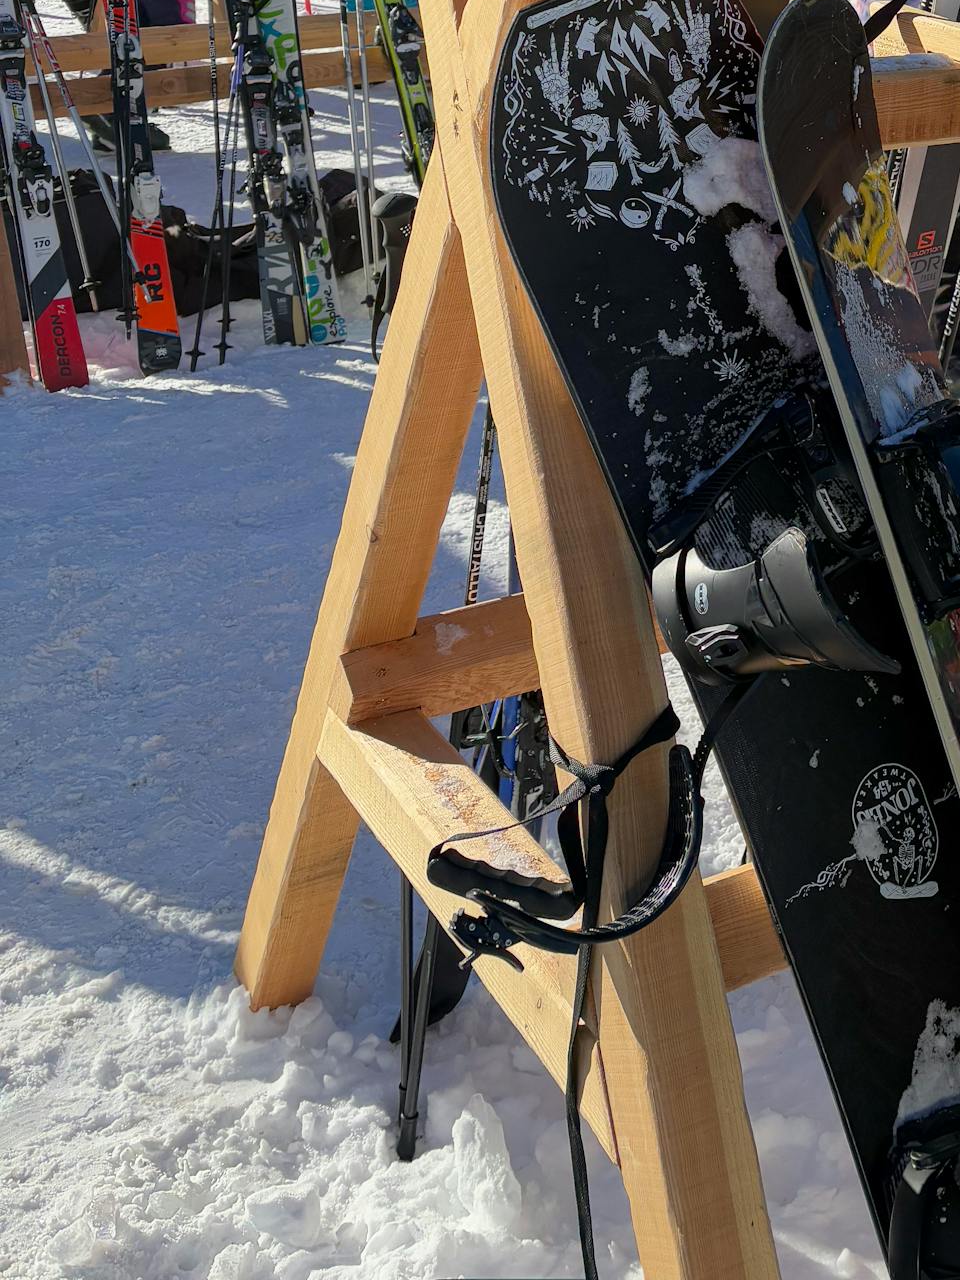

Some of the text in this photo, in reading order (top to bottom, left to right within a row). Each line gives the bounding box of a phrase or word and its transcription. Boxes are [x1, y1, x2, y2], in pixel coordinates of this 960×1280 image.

[34, 239, 51, 249] 170
[323, 284, 341, 338] explore
[51, 314, 73, 377] DEACON
[467, 513, 486, 603] CRISTALLO
[856, 768, 907, 808] TWEAKER
